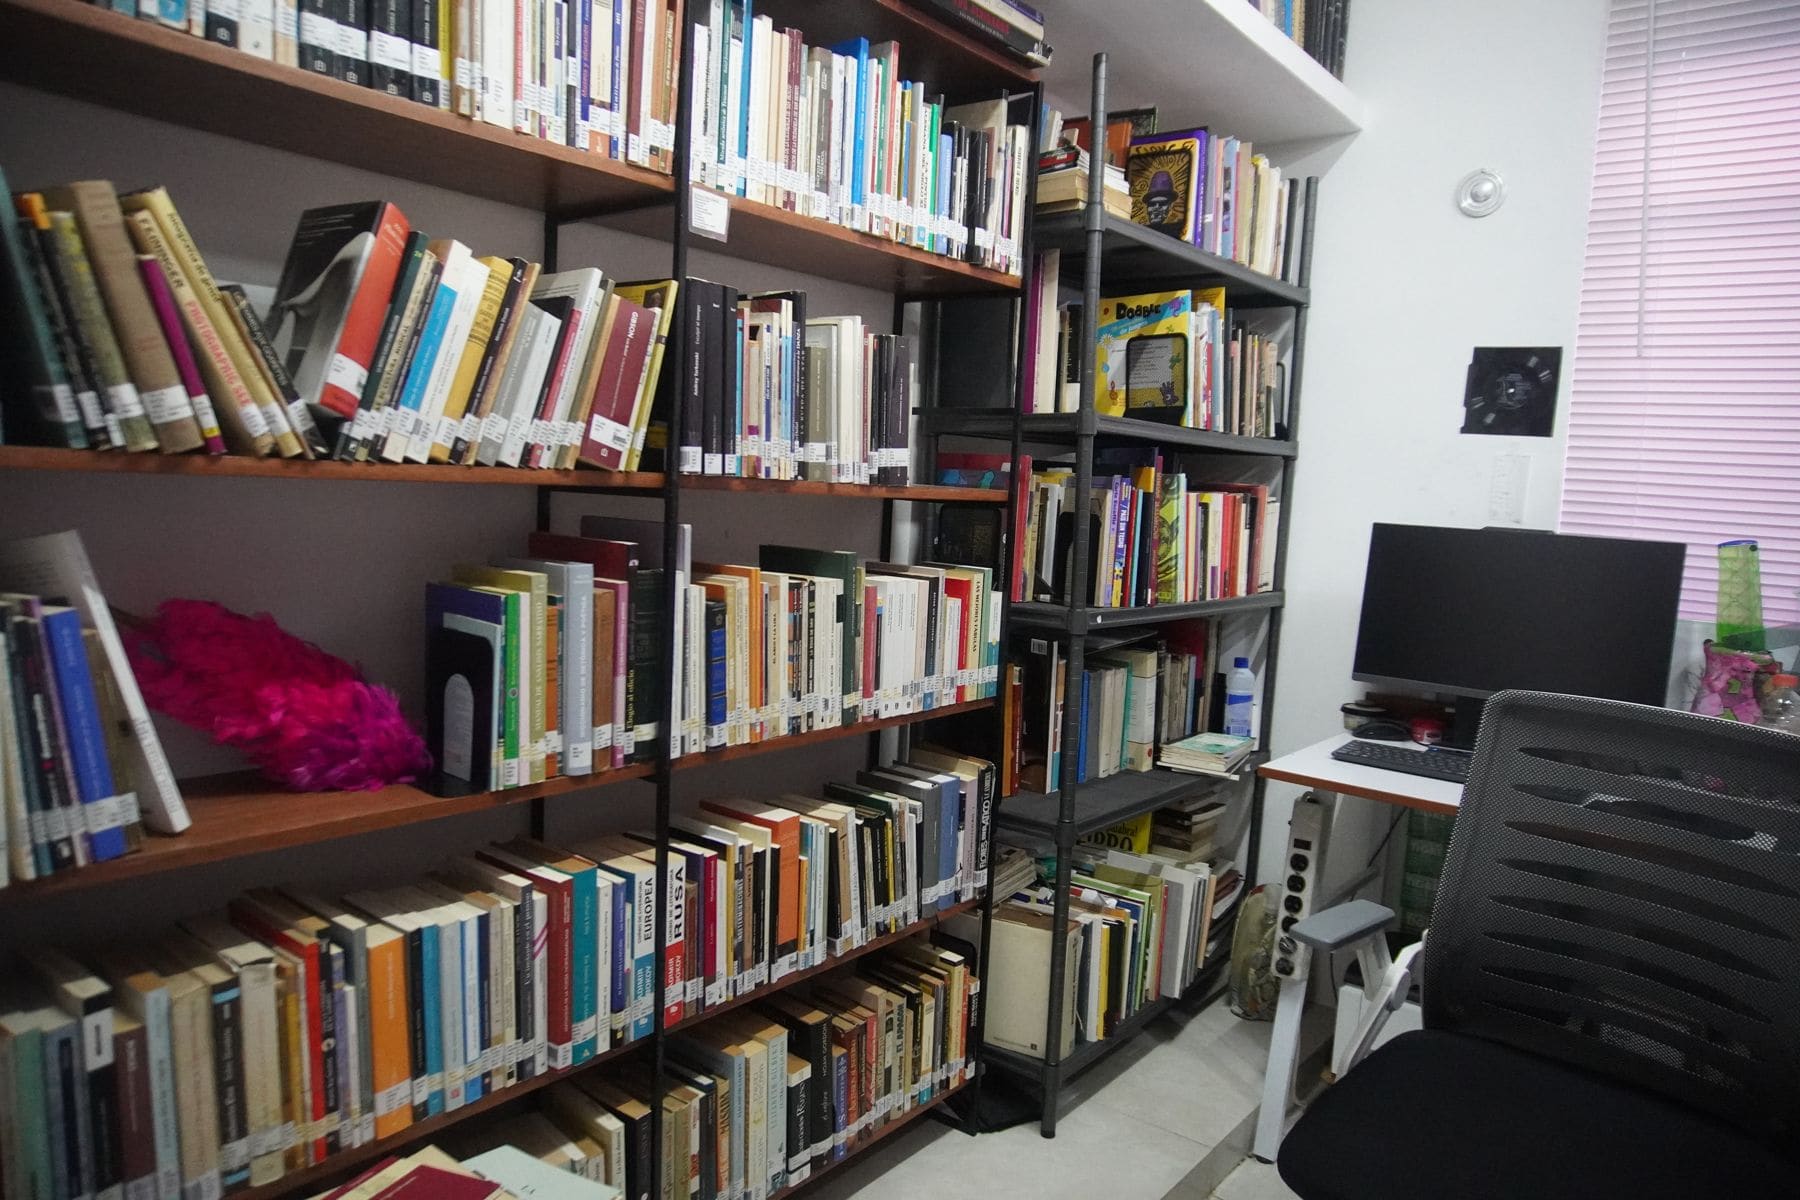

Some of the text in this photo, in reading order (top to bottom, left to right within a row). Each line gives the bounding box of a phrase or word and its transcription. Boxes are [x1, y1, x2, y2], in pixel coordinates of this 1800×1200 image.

[626, 311, 639, 338] GIBSON
[534, 601, 542, 645] NARRATIVO
[534, 685, 541, 695] DE
[626, 702, 634, 728] Elogio
[979, 839, 988, 868] FLORES
[644, 877, 652, 940] EUROPEA
[674, 866, 683, 937] RUSA
[896, 1041, 903, 1051] EL
[719, 1090, 729, 1133] MASADA
